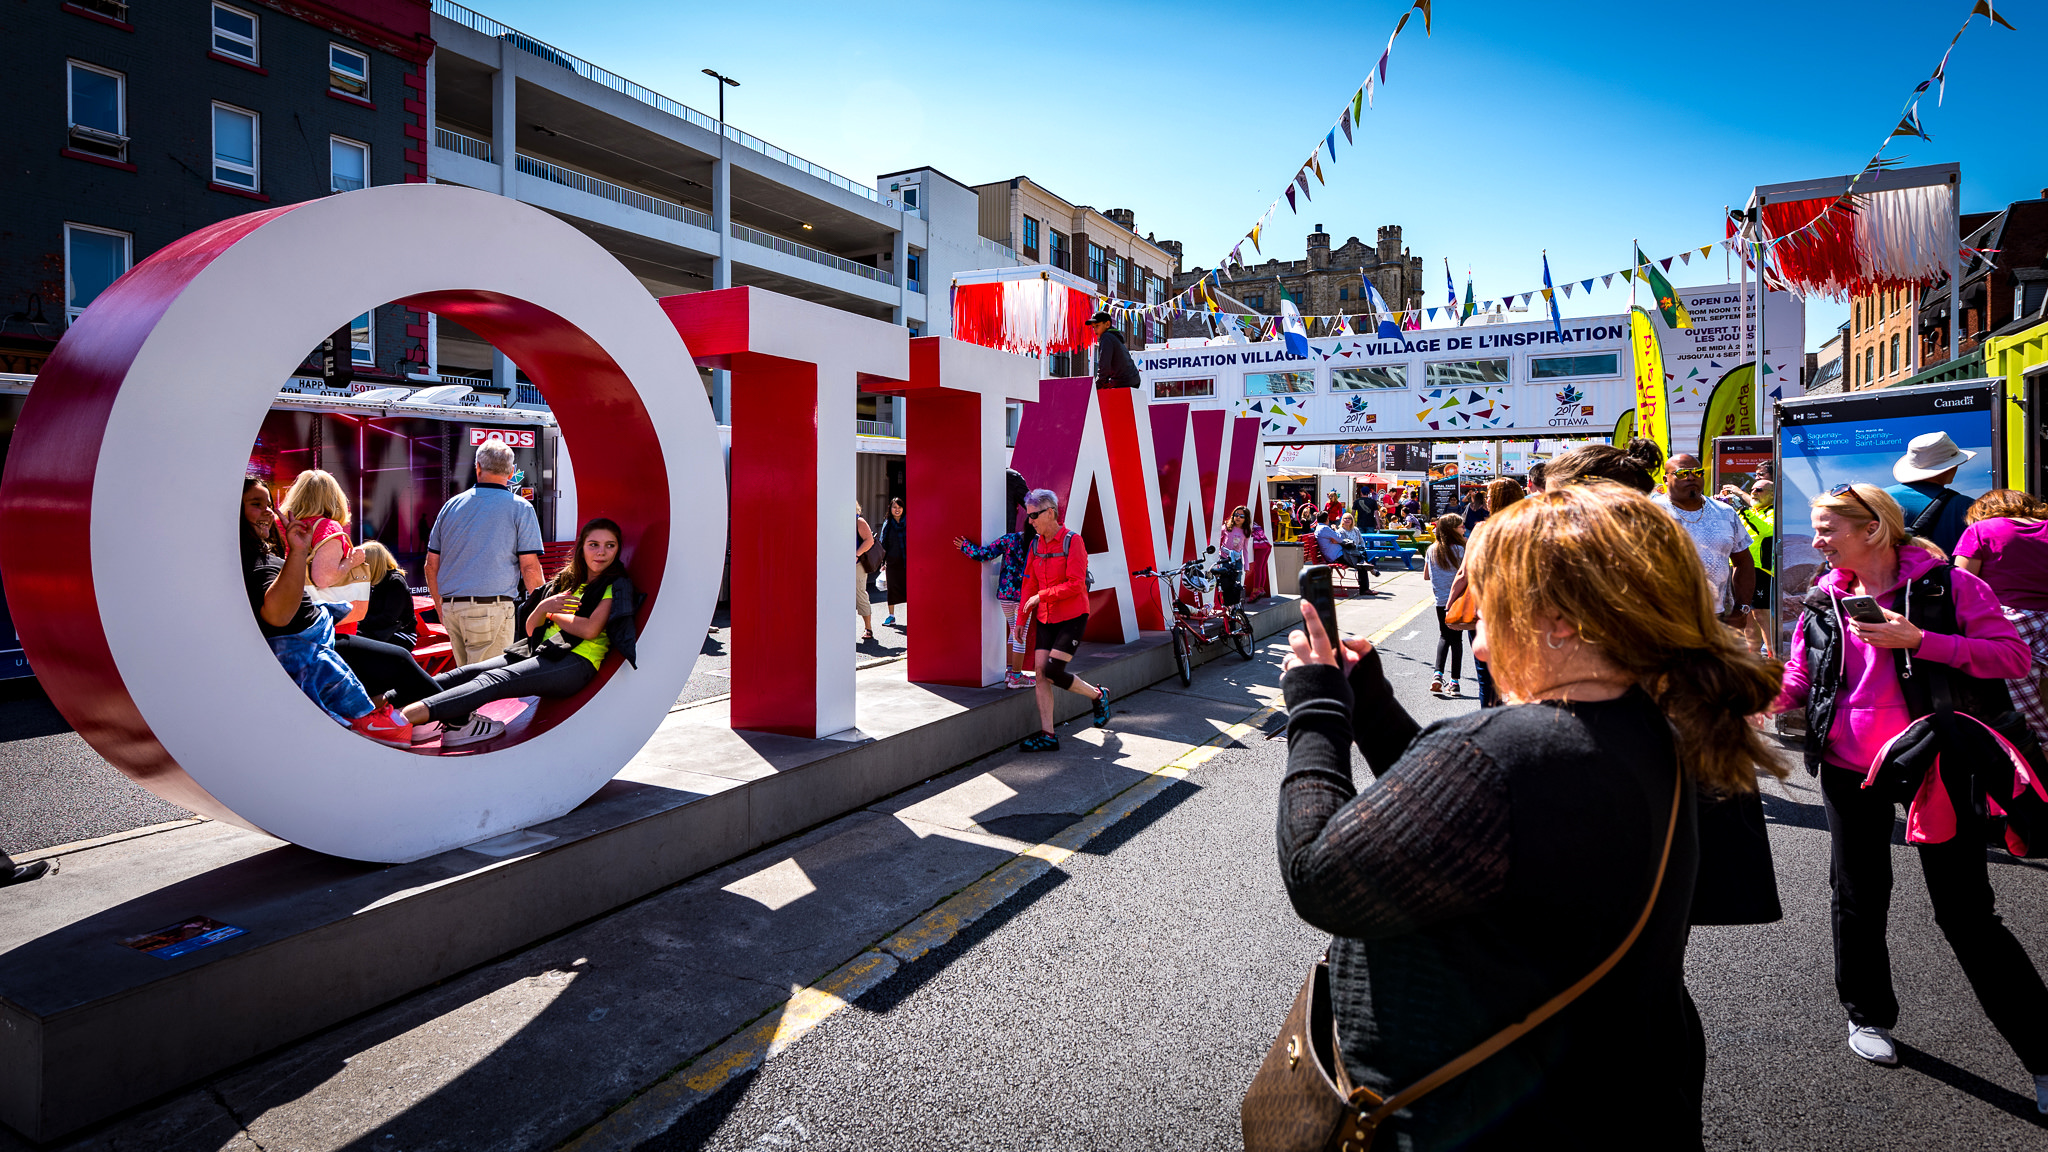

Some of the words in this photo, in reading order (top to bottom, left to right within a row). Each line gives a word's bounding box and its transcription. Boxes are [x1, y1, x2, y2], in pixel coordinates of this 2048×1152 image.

[887, 200, 893, 208] 5
[1691, 298, 1720, 306] OPEN
[1685, 327, 1728, 336] OUVERT
[1366, 339, 1440, 356] VILLAGE
[1447, 337, 1473, 350] DE
[1479, 325, 1623, 348] L'INSPIRATION
[1694, 335, 1715, 343] LES
[1145, 353, 1237, 371] INSPIRATION
[1241, 350, 1308, 364] VILLAGE
[1934, 395, 1974, 408] Canada
[1554, 403, 1580, 417] 2017
[1737, 383, 1751, 435] anada
[1344, 411, 1366, 424] 2017
[1548, 417, 1589, 427] OTTAWA
[1339, 425, 1373, 433] OTTAWA
[471, 430, 534, 446] PODS
[1855, 438, 1902, 447] Saint-Laurent
[0, 183, 1278, 864] OTTAWA
